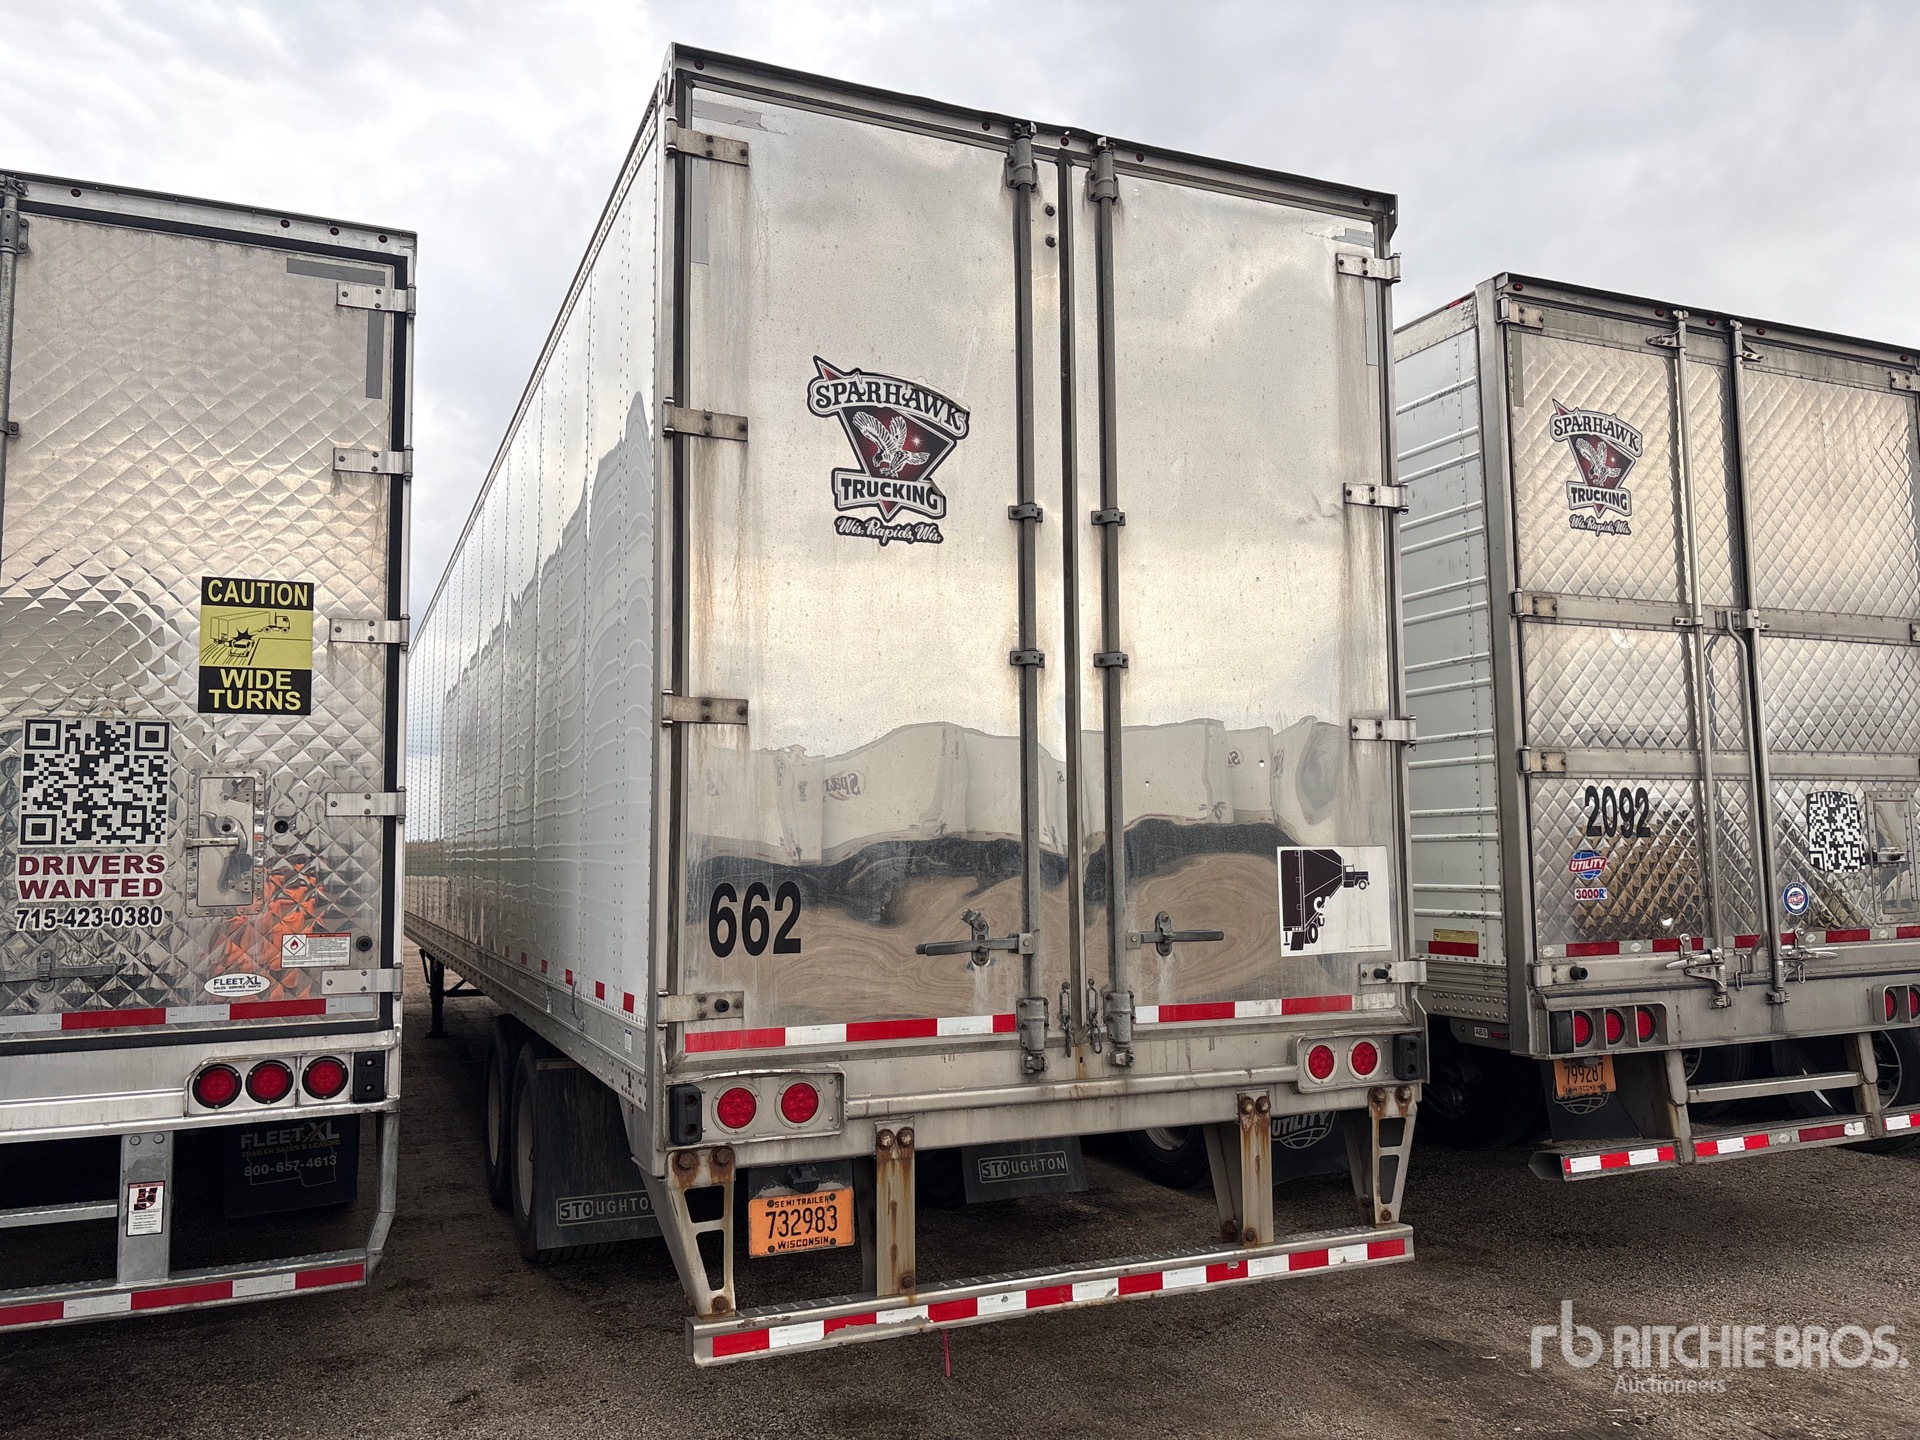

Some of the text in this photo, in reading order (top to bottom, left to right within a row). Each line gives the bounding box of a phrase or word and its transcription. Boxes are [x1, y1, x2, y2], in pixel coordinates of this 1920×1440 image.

[815, 381, 962, 430] SPARHAWK
[1554, 415, 1638, 451] SPARHAWK
[841, 478, 938, 510] TRUCKING
[1571, 487, 1628, 511] TRUCKING
[915, 524, 942, 542] Wis.
[207, 578, 308, 607] CAUTION
[219, 669, 292, 690] WIDE
[208, 689, 301, 711] TURNS
[1584, 785, 1651, 838] 2092
[18, 854, 165, 876] DRIVERS
[1571, 859, 1605, 871] UTILITY
[18, 878, 163, 900] WANTED
[16, 906, 163, 930] 715-423-0380
[708, 880, 801, 958] 662
[1475, 1028, 1487, 1037] ABS
[241, 1147, 274, 1158] TRAILER
[244, 1155, 337, 1177] 800-657-4613
[982, 1157, 1065, 1177] STOUGHTON
[774, 1195, 830, 1208] SEMI TRAILER
[765, 1204, 838, 1240] 732983
[778, 1235, 830, 1250] WISCONSIN
